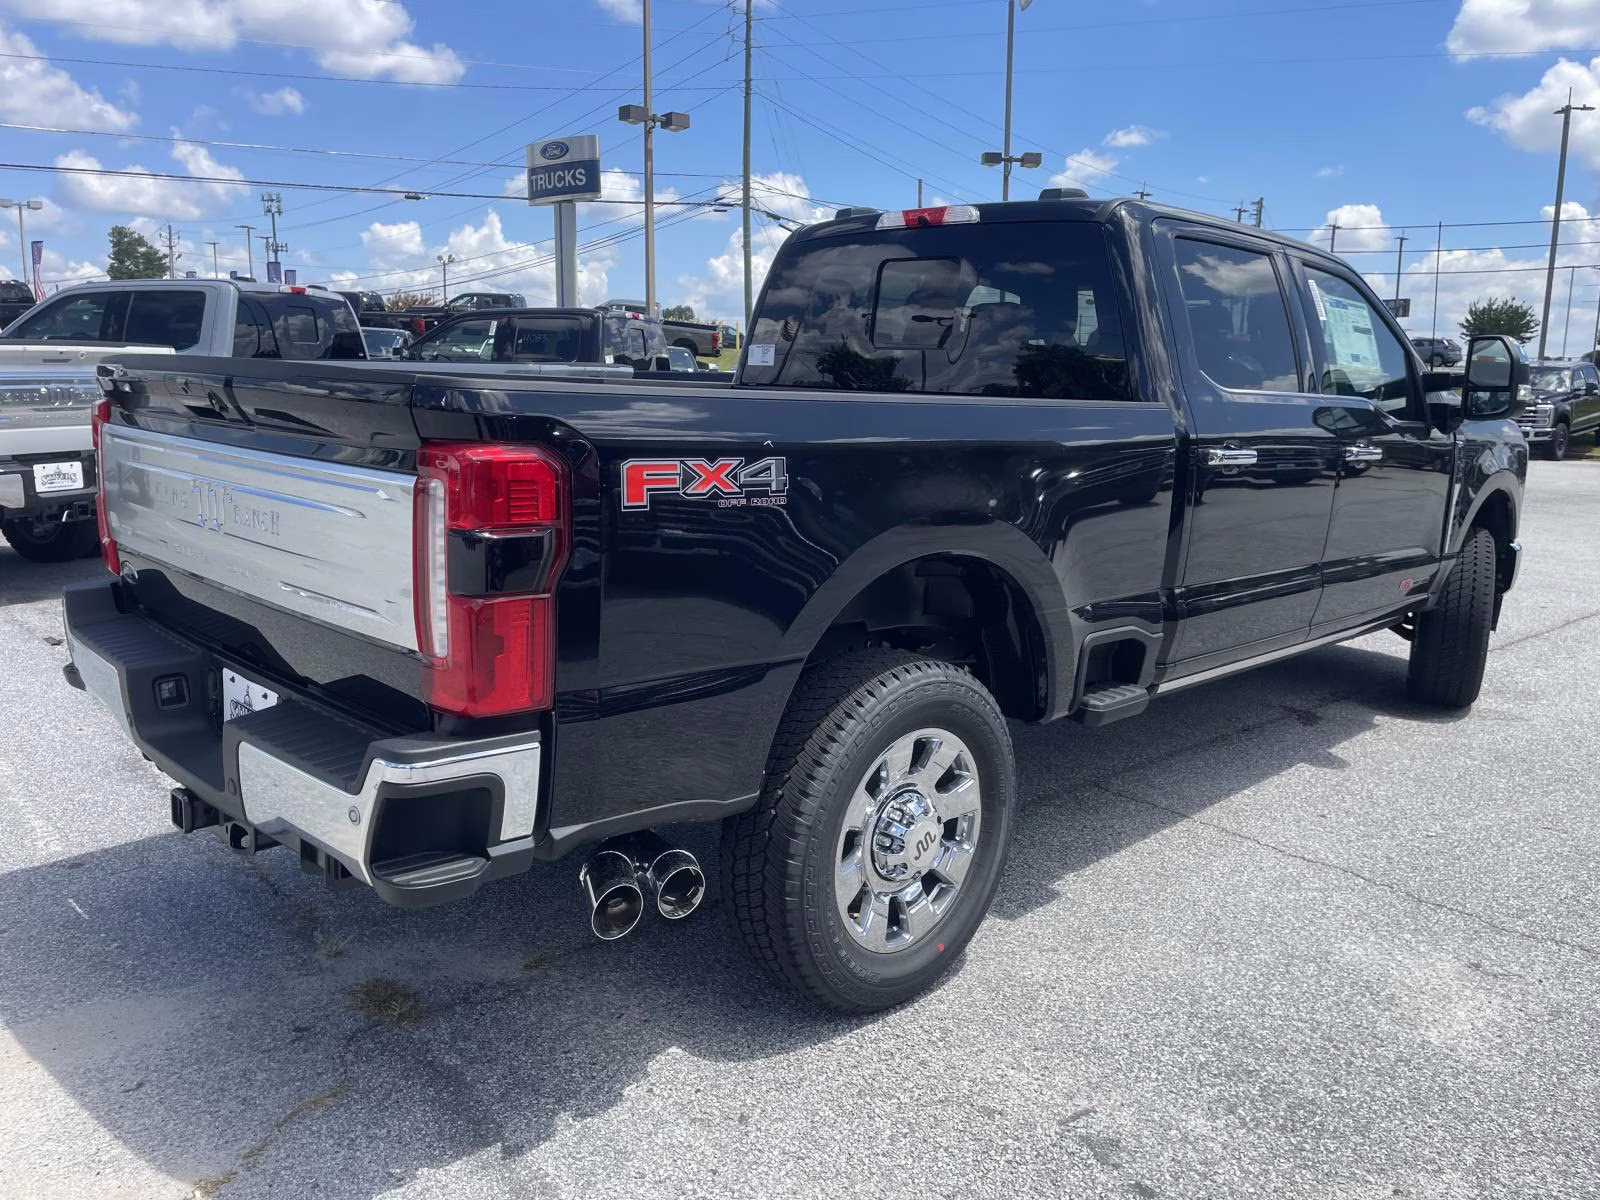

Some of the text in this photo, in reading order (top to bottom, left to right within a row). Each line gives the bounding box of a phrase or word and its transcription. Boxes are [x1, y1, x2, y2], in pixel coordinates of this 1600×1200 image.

[531, 168, 586, 191] TRUCKS
[621, 457, 789, 512] FX4
[717, 497, 788, 508] OFF ROAD
[233, 504, 281, 537] RANCH
